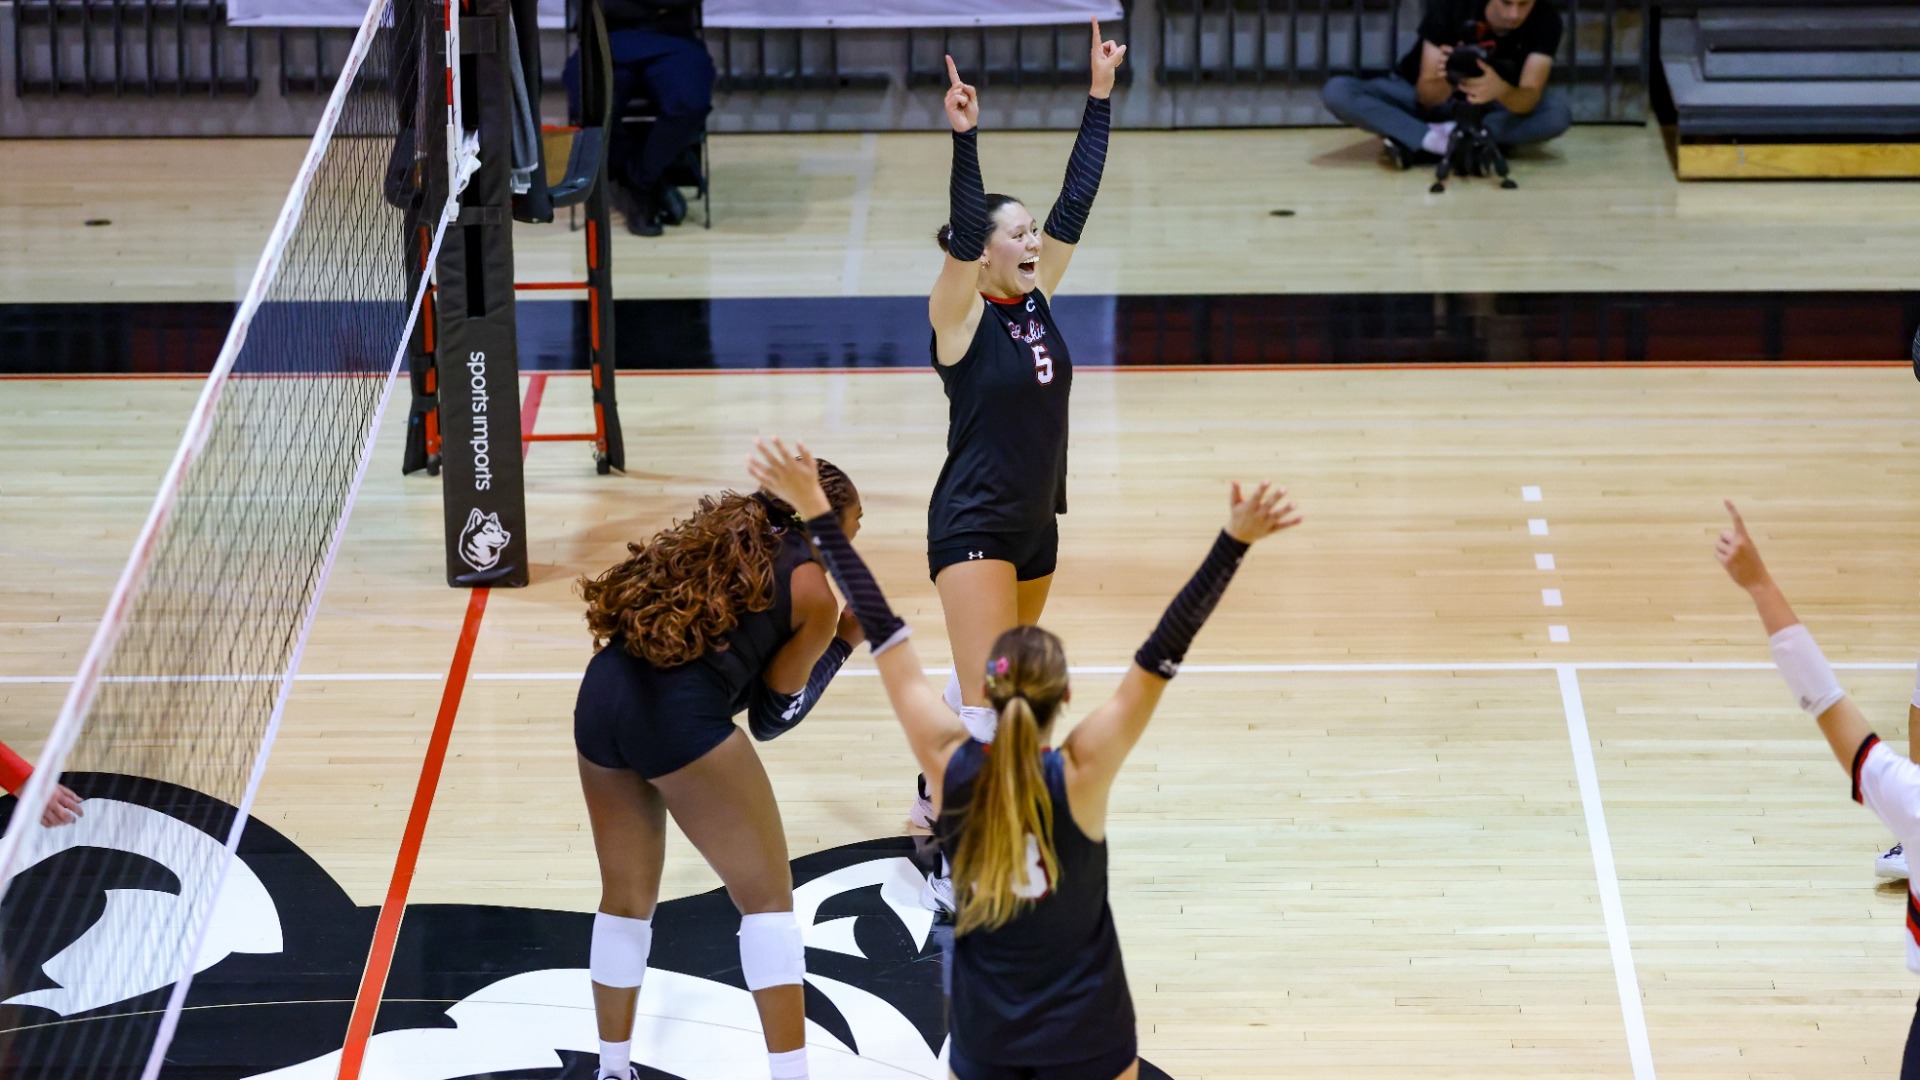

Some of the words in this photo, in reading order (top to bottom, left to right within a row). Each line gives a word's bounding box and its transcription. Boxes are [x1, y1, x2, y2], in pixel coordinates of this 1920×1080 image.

[466, 351, 489, 412] sports
[1031, 344, 1055, 385] 5
[469, 415, 492, 490] imports
